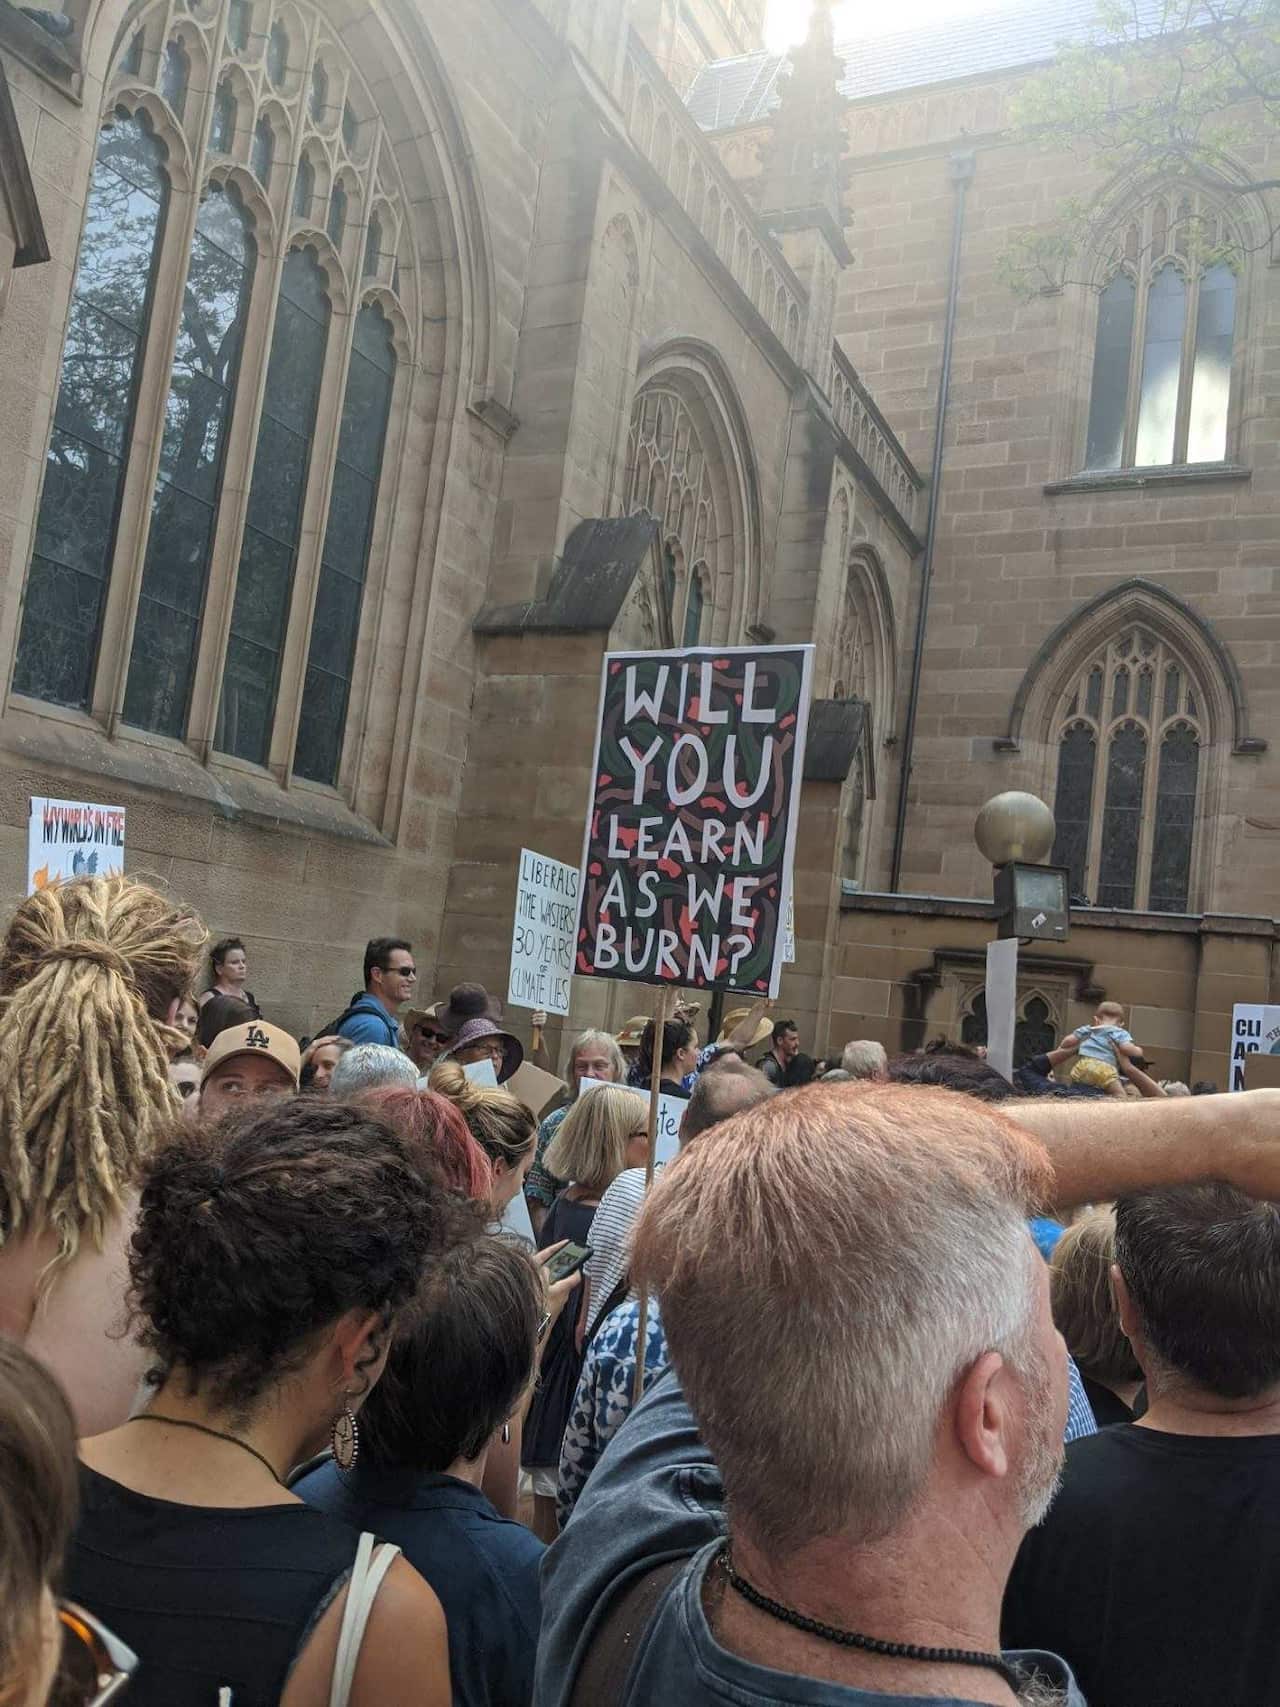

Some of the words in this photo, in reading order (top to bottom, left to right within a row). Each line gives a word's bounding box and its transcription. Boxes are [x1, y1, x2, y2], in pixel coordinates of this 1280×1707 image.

[624, 661, 776, 725] WILL
[618, 733, 774, 809] YOU
[608, 814, 766, 866] LEARN
[522, 854, 578, 898] LIBERALS
[599, 869, 661, 918] AS
[687, 873, 760, 928] WE
[519, 889, 537, 920] TIME
[540, 899, 576, 935] WASTERS
[514, 926, 535, 956] 30
[537, 933, 573, 970] YEARS
[593, 923, 753, 986] BURN?
[510, 967, 546, 1005] CLIMATE
[549, 976, 569, 1010] LIES
[245, 1025, 270, 1049] LA
